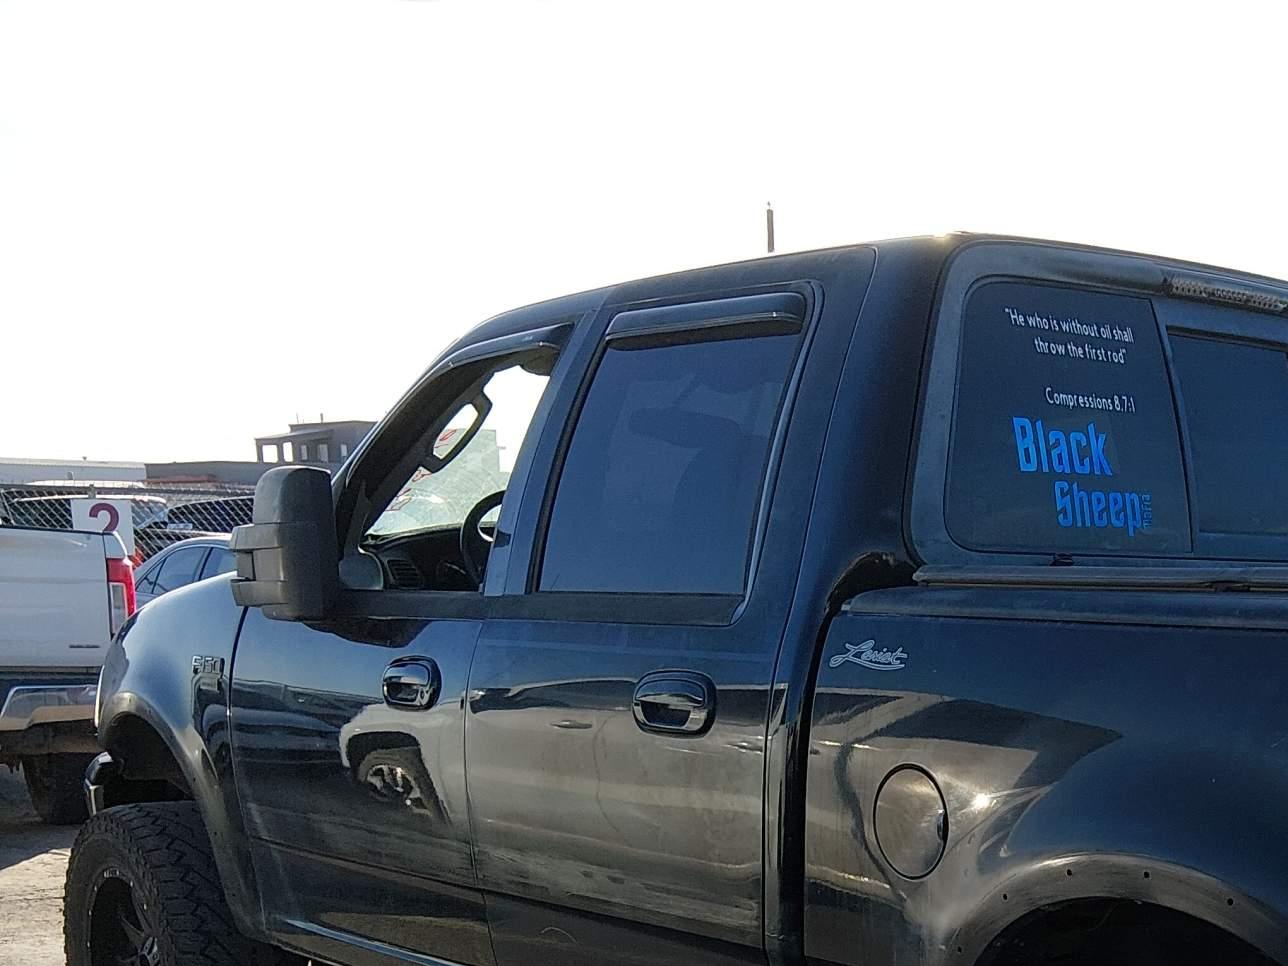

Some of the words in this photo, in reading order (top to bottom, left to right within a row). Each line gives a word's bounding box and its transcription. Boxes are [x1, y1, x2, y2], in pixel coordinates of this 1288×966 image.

[1026, 311, 1049, 330] who
[1049, 314, 1059, 331] is
[1060, 318, 1100, 338] without
[1100, 324, 1112, 340] oil
[1112, 325, 1134, 343] shall
[1034, 336, 1065, 356] throw
[1066, 341, 1084, 358] the
[1085, 343, 1107, 362] first
[1045, 387, 1113, 410] Compressions
[1113, 394, 1136, 413] 8.7:1
[1012, 416, 1113, 476] Black
[1054, 480, 1142, 537] Sheep
